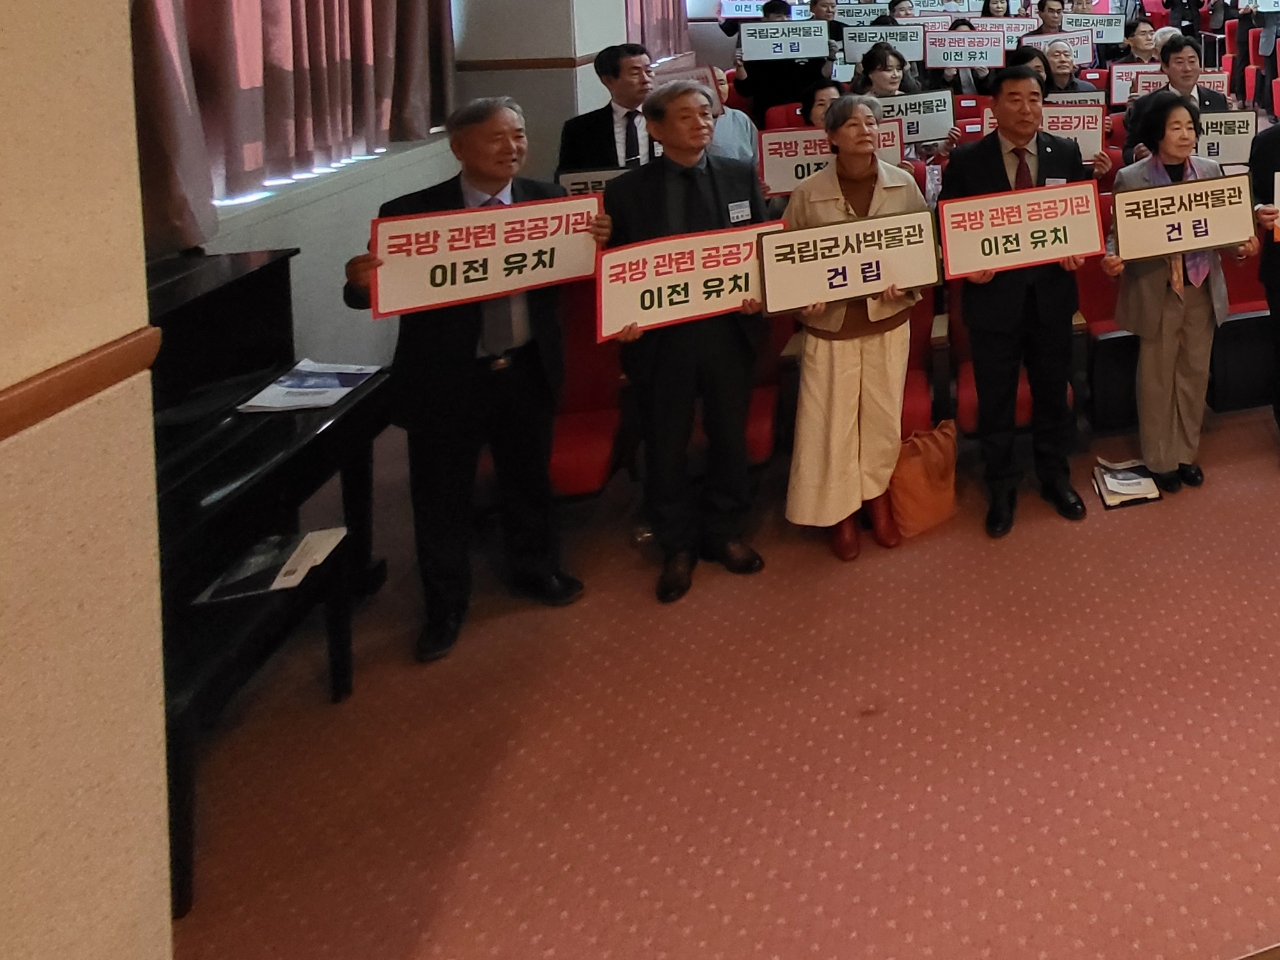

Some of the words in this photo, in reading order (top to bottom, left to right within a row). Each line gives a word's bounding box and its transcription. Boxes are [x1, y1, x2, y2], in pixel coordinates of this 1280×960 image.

[746, 27, 823, 39] 국립군사박물관
[1066, 18, 1122, 27] 국립군사박물관
[848, 31, 919, 43] 국립군사박물관
[929, 37, 947, 48] 국방
[948, 37, 966, 47] 관련
[967, 36, 1001, 47] 공공기관
[772, 42, 783, 54] 건
[789, 42, 800, 52] 립
[942, 50, 963, 61] 이전
[967, 50, 988, 61] 유치
[907, 121, 919, 135] 립
[1048, 115, 1099, 130] 공공기관
[768, 141, 799, 158] 국방
[1207, 142, 1220, 156] 립
[950, 210, 985, 232] 국방
[988, 204, 1023, 228] 관련
[1026, 194, 1091, 222] 공공기관
[1125, 186, 1243, 220] 국립군사박물관
[387, 230, 440, 257] 국방
[447, 223, 497, 253] 관련
[503, 211, 593, 245] 공공기관
[980, 233, 1021, 257] 이전
[1029, 225, 1069, 249] 유치
[1166, 223, 1183, 243] 건
[1192, 218, 1210, 239] 립
[774, 224, 925, 265] 국립군사박물관
[429, 257, 489, 288] 이전
[503, 247, 556, 278] 유치
[609, 259, 648, 287] 국방
[653, 249, 696, 277] 관련
[701, 240, 760, 270] 공공기
[827, 266, 849, 290] 건
[860, 260, 882, 284] 립
[640, 282, 690, 311] 이전
[702, 273, 750, 301] 유치
